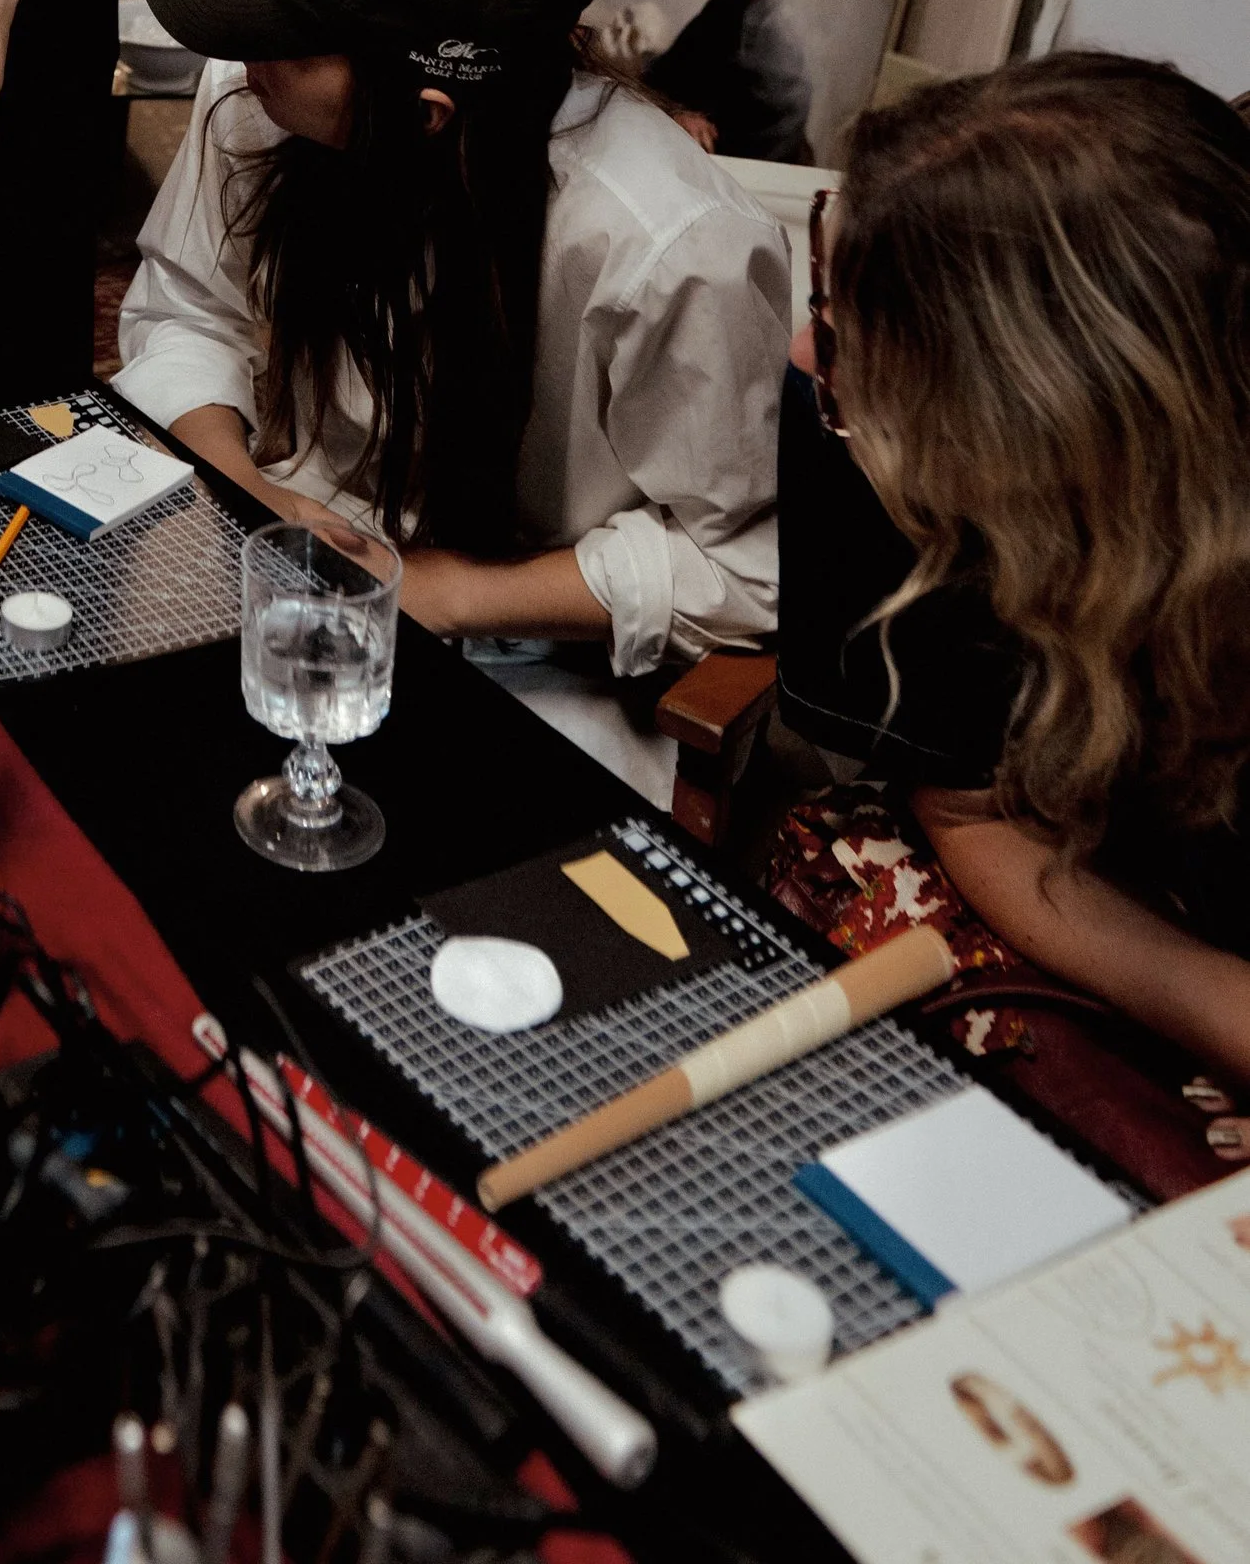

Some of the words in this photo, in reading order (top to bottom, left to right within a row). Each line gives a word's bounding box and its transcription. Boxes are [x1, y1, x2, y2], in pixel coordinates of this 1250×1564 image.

[409, 50, 453, 70] SANTA
[459, 63, 502, 74] MARIA
[425, 67, 453, 78] GOLF
[456, 73, 483, 81] CLUB
